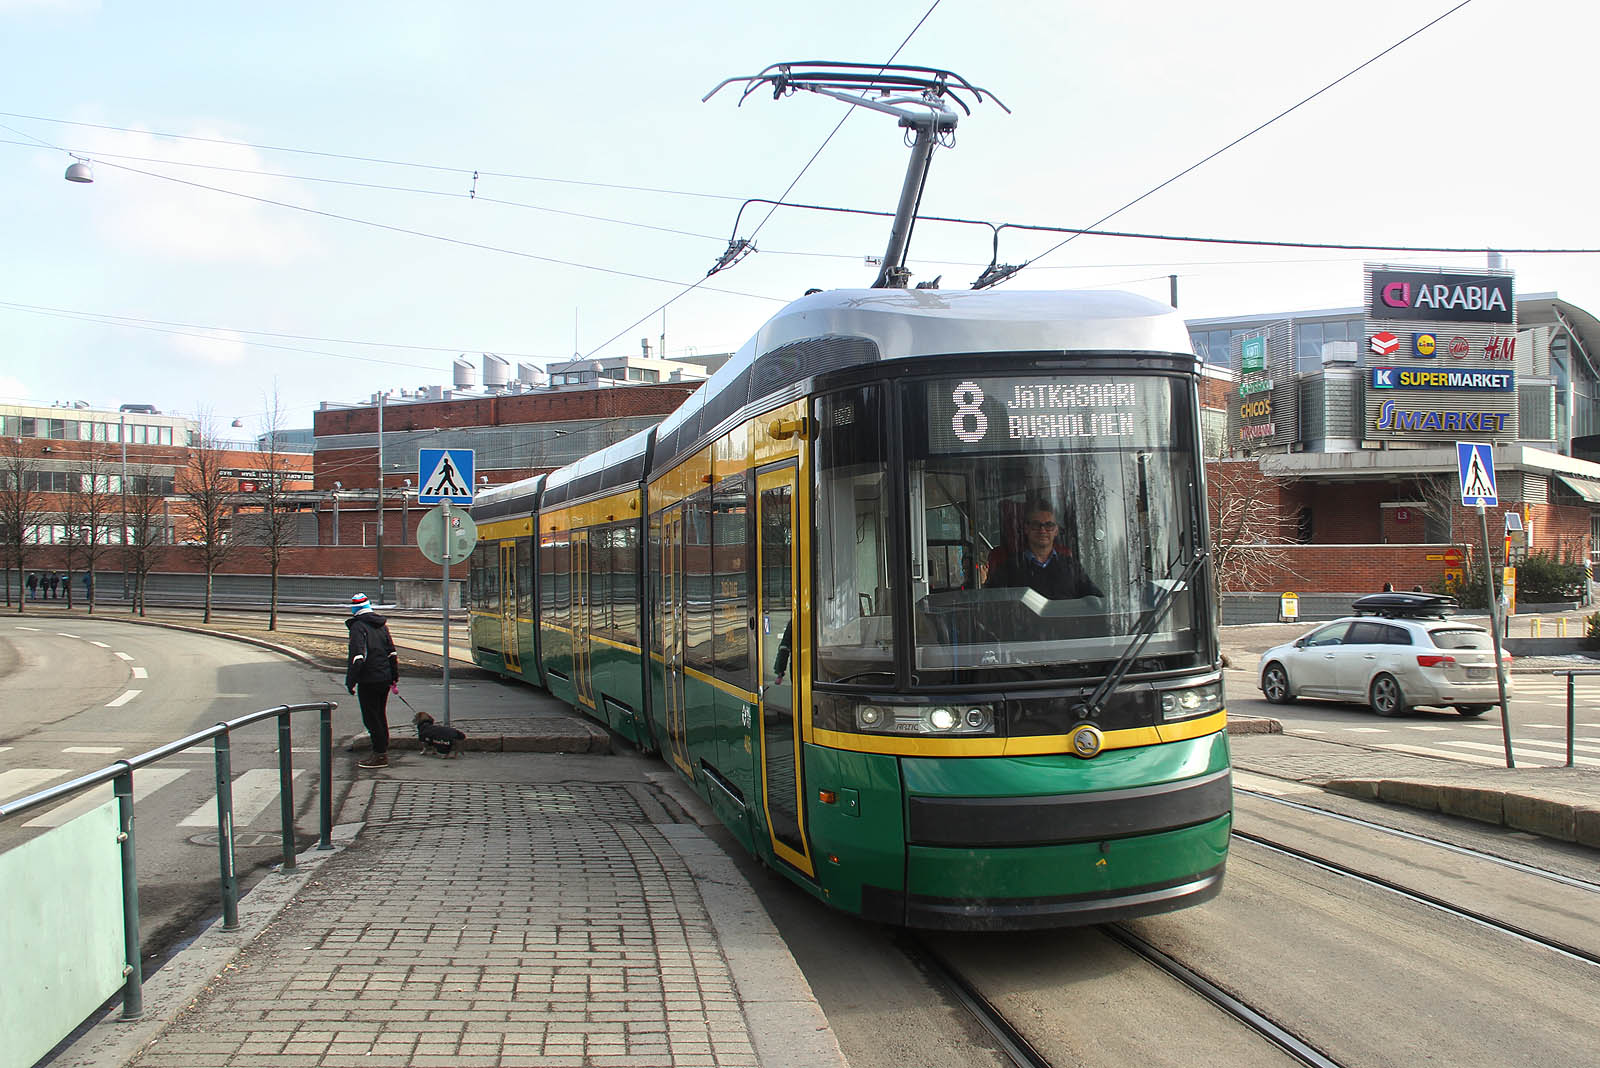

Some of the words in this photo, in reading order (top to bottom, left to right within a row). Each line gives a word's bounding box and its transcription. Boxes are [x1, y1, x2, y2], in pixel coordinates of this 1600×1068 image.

[1413, 283, 1507, 312] ARABIA
[1377, 370, 1392, 385] K
[1400, 371, 1511, 388] SUPERMARKET
[951, 381, 988, 443] 8
[1008, 412, 1135, 439] BUSHOLMEN
[1397, 511, 1408, 520] L3
